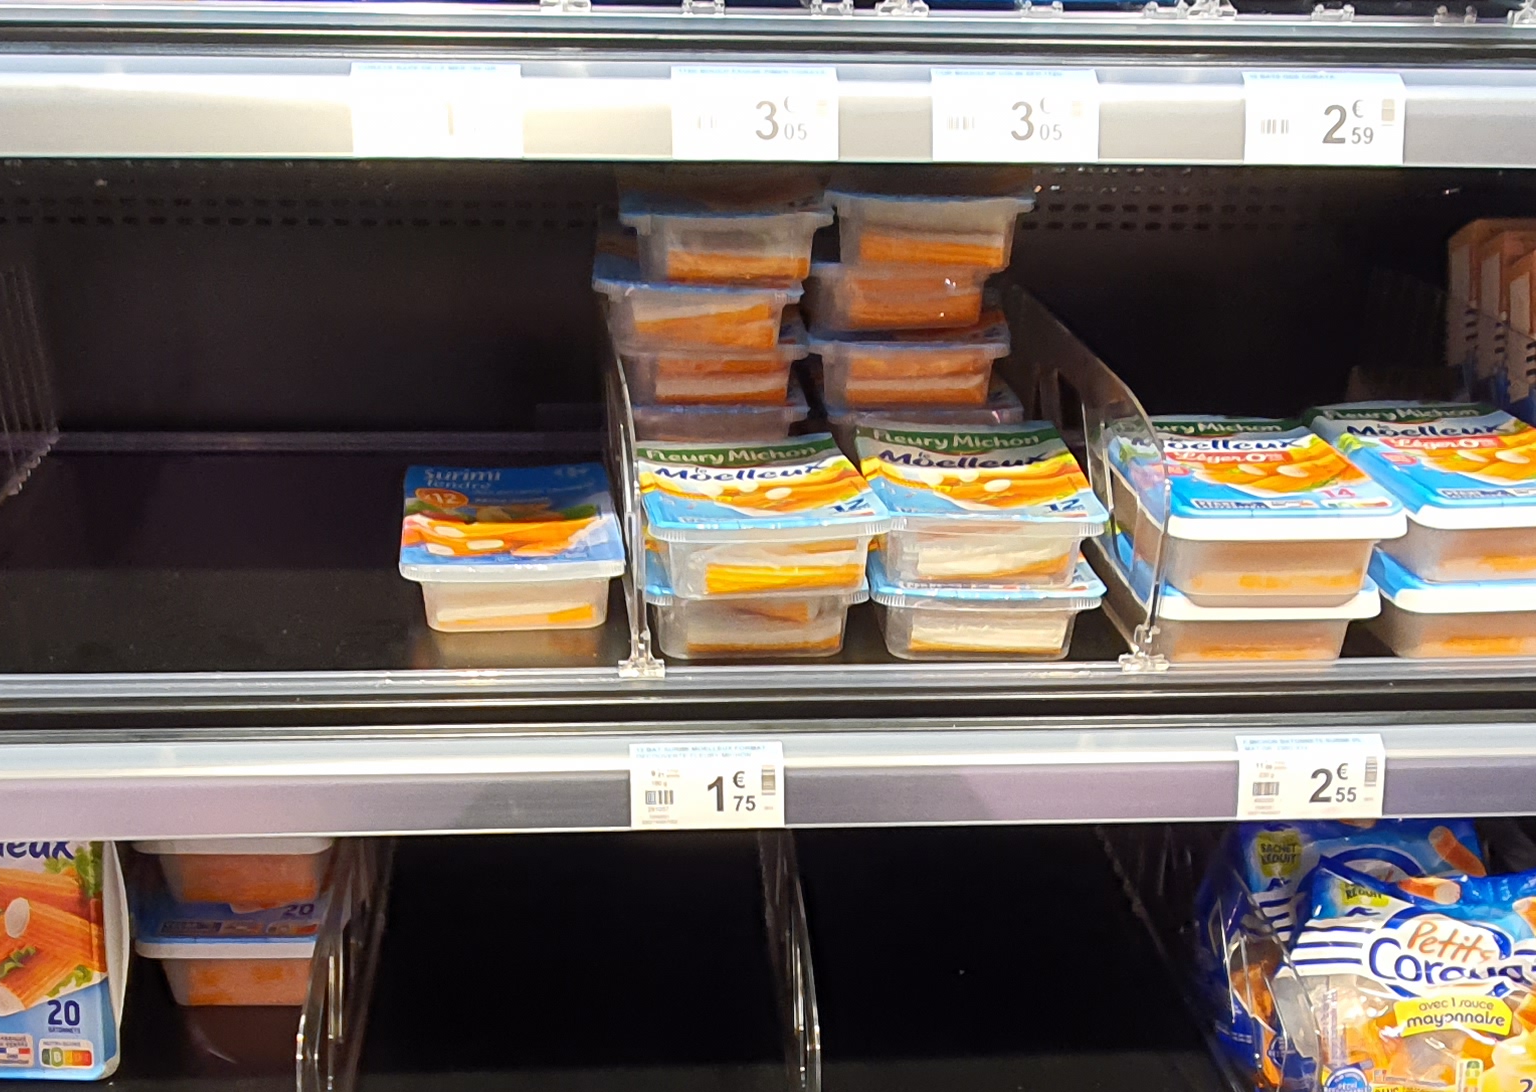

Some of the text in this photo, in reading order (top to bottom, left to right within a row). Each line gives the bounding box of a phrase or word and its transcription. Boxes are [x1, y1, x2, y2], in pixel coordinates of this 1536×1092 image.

[877, 449, 1048, 469] Moelleux
[654, 460, 827, 482] Moelleux
[1406, 918, 1496, 964] Petits
[46, 998, 80, 1027] 20
[1417, 1000, 1449, 1012] avec
[1406, 1010, 1506, 1030] mayonnaise
